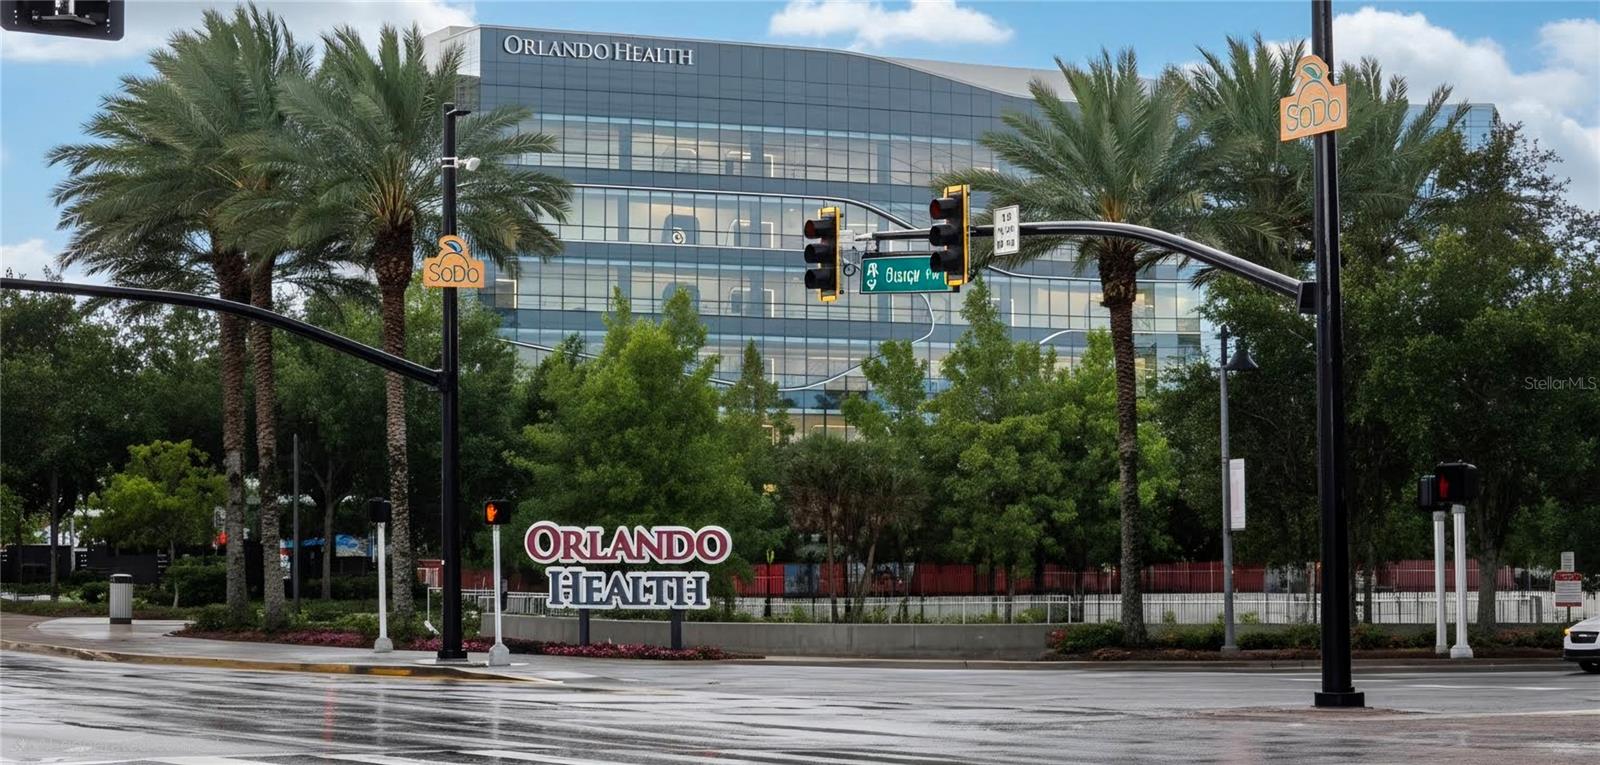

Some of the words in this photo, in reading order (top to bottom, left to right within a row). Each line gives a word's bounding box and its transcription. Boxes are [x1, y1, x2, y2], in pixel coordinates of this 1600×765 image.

[503, 34, 609, 60] ORLANDO
[612, 42, 694, 65] HEALTH
[525, 522, 732, 563] ORLANDO
[547, 568, 708, 607] HEALTH
